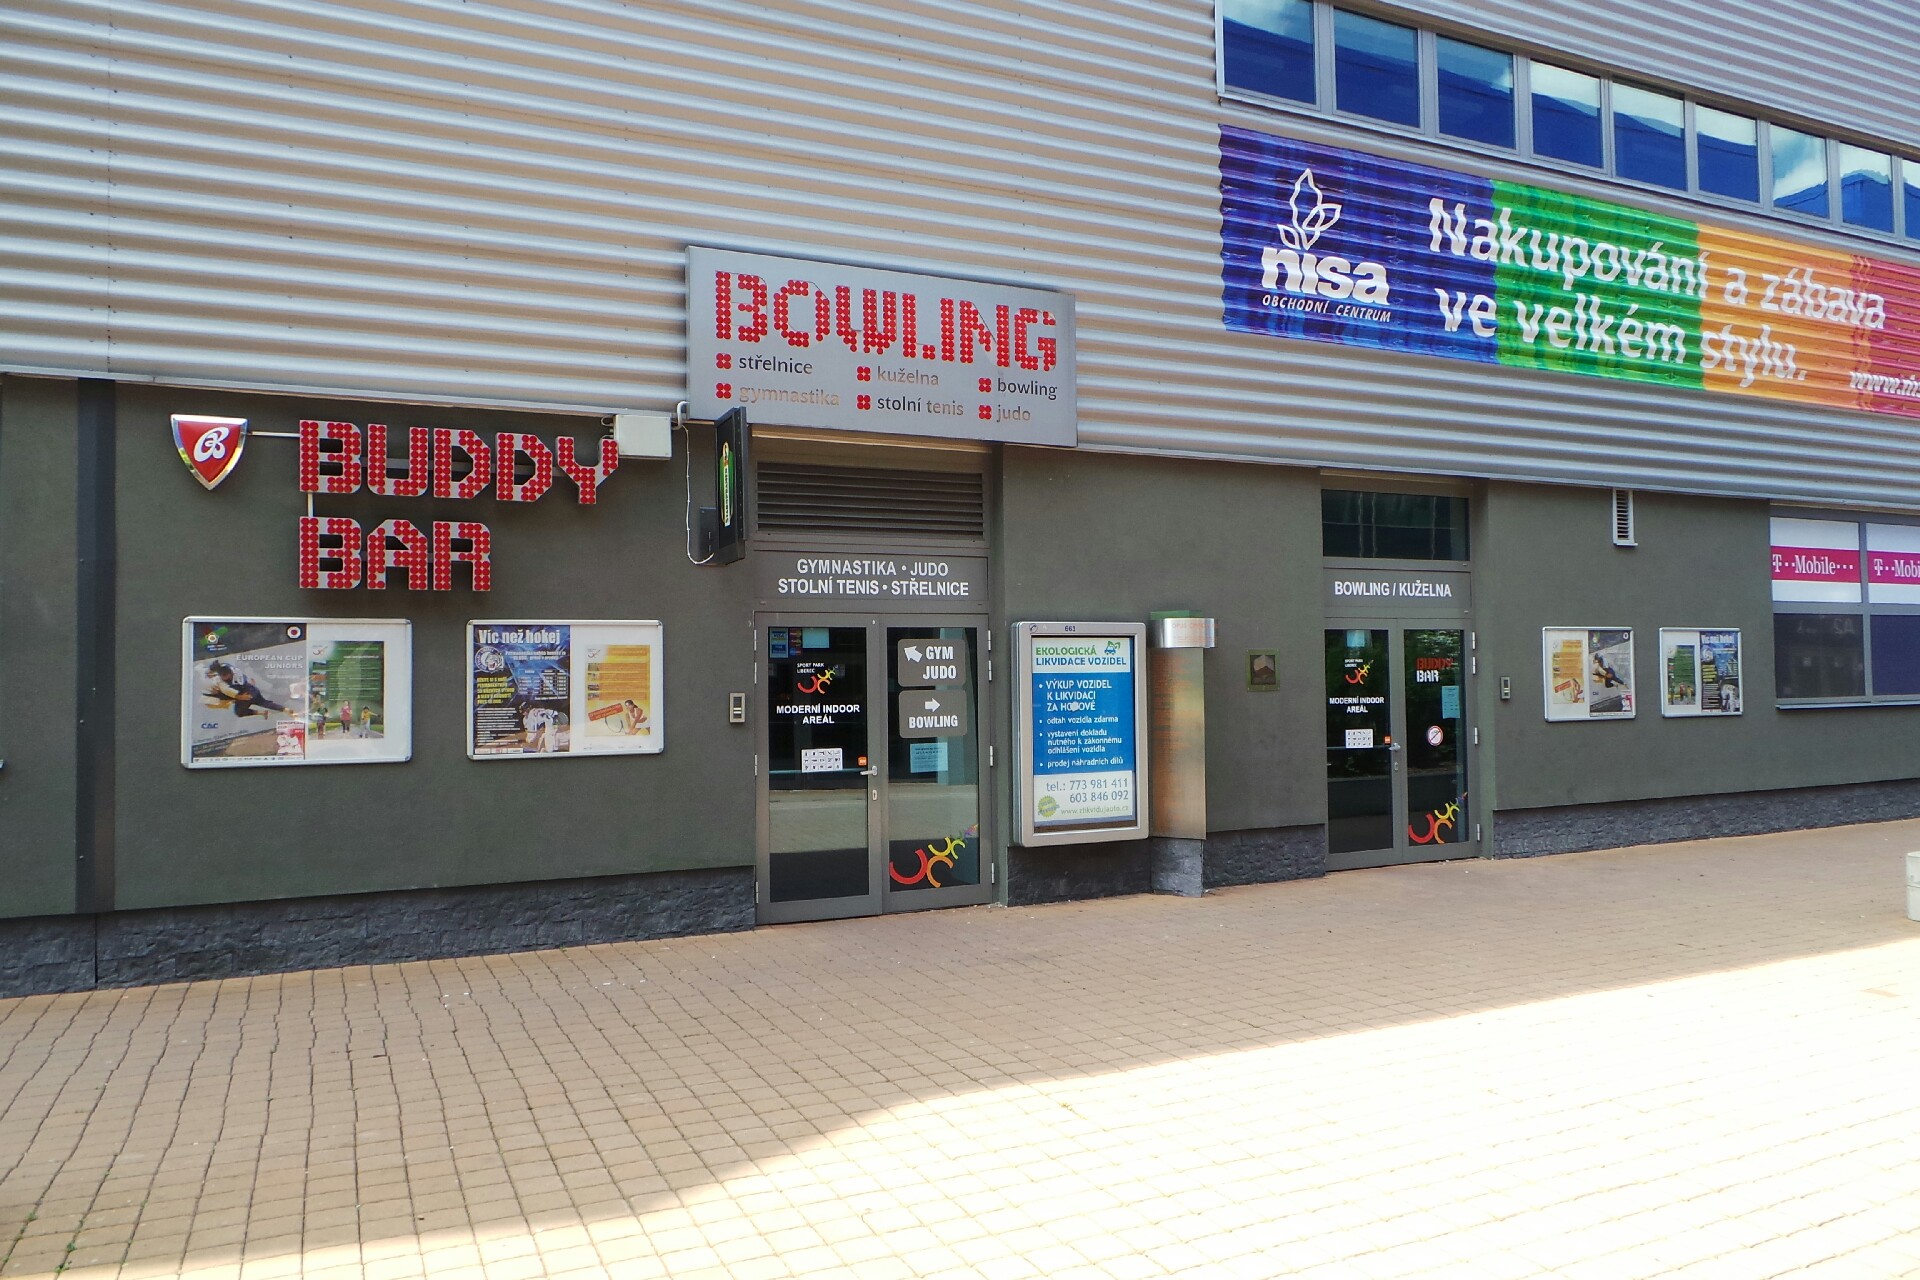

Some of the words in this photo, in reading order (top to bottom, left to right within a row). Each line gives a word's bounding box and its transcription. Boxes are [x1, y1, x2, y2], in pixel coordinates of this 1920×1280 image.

[1429, 197, 1710, 299] Nakupování
[1724, 267, 1748, 306] a
[1759, 267, 1886, 329] zábava
[1261, 247, 1391, 305] nisa
[1262, 294, 1330, 314] OBCHODNÍ
[1335, 304, 1392, 323] CENTRUM
[715, 270, 1057, 372] BOWLING
[1434, 288, 1498, 338] ve
[1513, 292, 1687, 364] velkém
[1700, 323, 1808, 388] stylu.
[738, 354, 813, 374] střelnice
[877, 366, 940, 386] kuželna
[738, 386, 840, 406] gymnastika
[997, 378, 1058, 401] bowling
[877, 395, 922, 413] stolní
[926, 400, 964, 416] tenis
[996, 405, 1031, 422] judo
[299, 419, 619, 505] BUDDY
[299, 515, 491, 592] BAR
[796, 558, 897, 576] GYMNASTIKA
[910, 562, 949, 577] JUDO
[778, 576, 833, 595] STOLNÍ
[836, 579, 880, 596] TENIS
[890, 577, 969, 596] STŘELNICE
[1334, 581, 1390, 597] BOWLING
[1399, 579, 1452, 598] KUŽELNA
[502, 629, 524, 644] než
[525, 629, 561, 645] hokej
[925, 646, 954, 660] GYM
[1035, 645, 1097, 656] EKOLOGICKÁ
[1036, 657, 1086, 666] LIKVIDACE
[1088, 657, 1127, 666] VOZIDEL
[922, 665, 957, 680] JUDO
[1416, 670, 1440, 683] BAR
[1045, 678, 1075, 689] VÝKUP
[1077, 680, 1112, 689] VOZIDEL
[1047, 691, 1054, 701] K
[1329, 696, 1359, 705] MODERNÍ
[776, 703, 821, 714] MODERNÍ
[823, 704, 860, 713] INDOOR
[1047, 702, 1058, 712] ZA
[1060, 700, 1096, 712] HOOVÉ
[1346, 705, 1369, 713] AREÁL
[802, 714, 835, 724] AREÁL
[908, 715, 959, 729] BOWLING
[1046, 716, 1067, 724] odtah
[1068, 716, 1092, 724] vozidla
[1094, 715, 1119, 723] zdarma
[1080, 728, 1107, 736] dokladu
[1047, 738, 1076, 746] nutného
[1077, 737, 1082, 745] k
[1084, 737, 1122, 745] zákonnému
[1082, 745, 1106, 753] vozidla
[1047, 760, 1070, 768] prodej
[1046, 781, 1066, 792] tel.:
[1069, 779, 1088, 791] 773
[1090, 778, 1108, 789] 981
[1111, 778, 1129, 788] 411
[1069, 793, 1088, 803] 603
[1090, 791, 1109, 802] 846
[1111, 790, 1129, 800] 092
[1060, 805, 1129, 815] www.zlikvidujauto.cz
